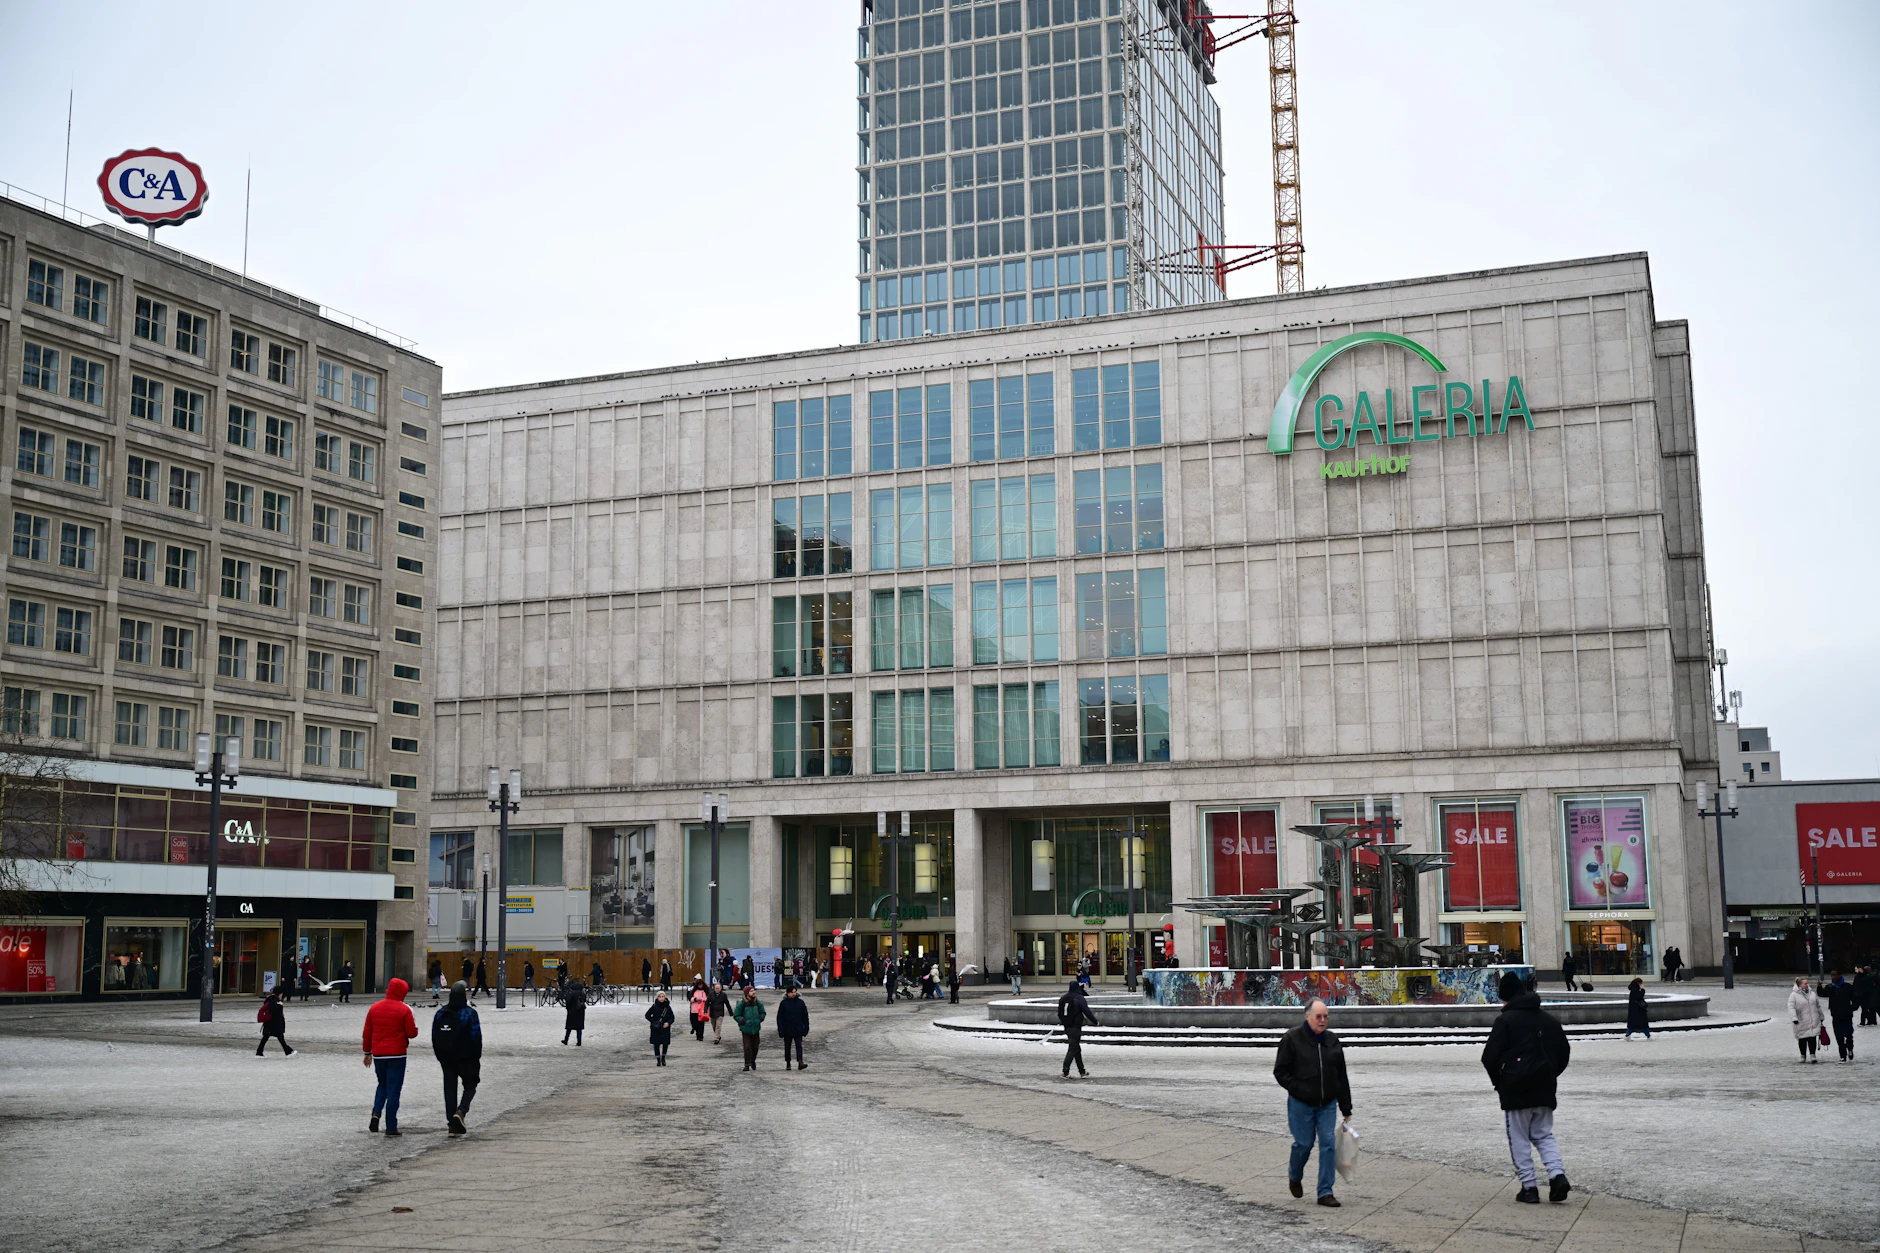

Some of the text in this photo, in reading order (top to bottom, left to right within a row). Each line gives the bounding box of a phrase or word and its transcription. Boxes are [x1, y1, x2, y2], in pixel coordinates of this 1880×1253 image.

[119, 168, 187, 201] C&A
[1314, 375, 1536, 451] GALERIA
[1580, 815, 1600, 824] BIG
[224, 819, 256, 843] C&A
[1455, 828, 1508, 844] SALE
[1808, 827, 1877, 848] SALE
[172, 838, 187, 847] Sale
[1221, 836, 1276, 855] SALE
[172, 852, 185, 860] 50%
[240, 903, 254, 913] C&A
[0, 927, 32, 952] ale
[28, 966, 43, 974] 50%
